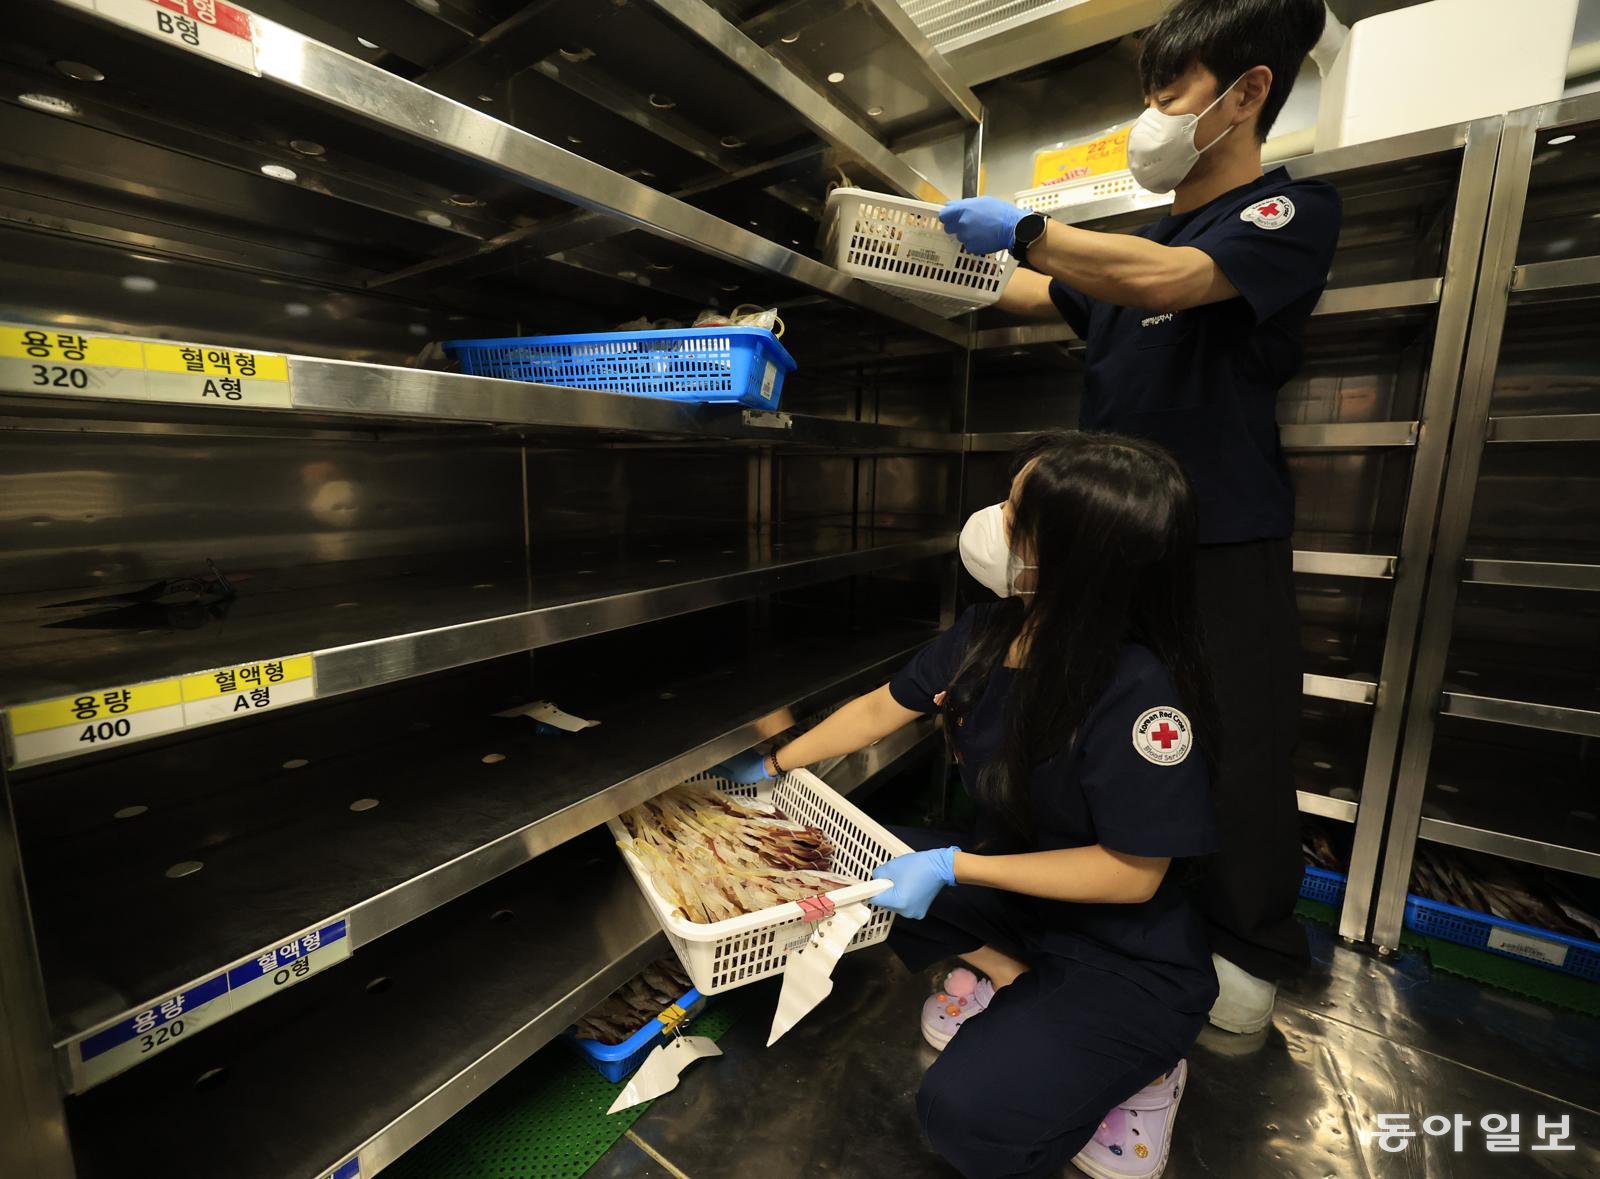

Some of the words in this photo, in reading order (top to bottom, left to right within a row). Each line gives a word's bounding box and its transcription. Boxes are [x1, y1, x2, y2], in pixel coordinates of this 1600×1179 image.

[157, 10, 200, 46] B형
[21, 330, 88, 361] 용량
[181, 347, 257, 377] 혈액형
[31, 364, 88, 389] 320
[201, 376, 243, 401] A형
[71, 689, 132, 720] 용량
[214, 660, 285, 693] 혈액형
[79, 718, 131, 743] 400
[233, 686, 271, 712] A형
[1139, 713, 1159, 735] Korean
[1159, 711, 1173, 719] Red
[1172, 714, 1186, 733] Cross
[1143, 745, 1163, 761] Blood
[132, 994, 185, 1035] 용량
[257, 930, 321, 973] 혈액형
[140, 1019, 185, 1054] 320
[273, 954, 310, 986] O형
